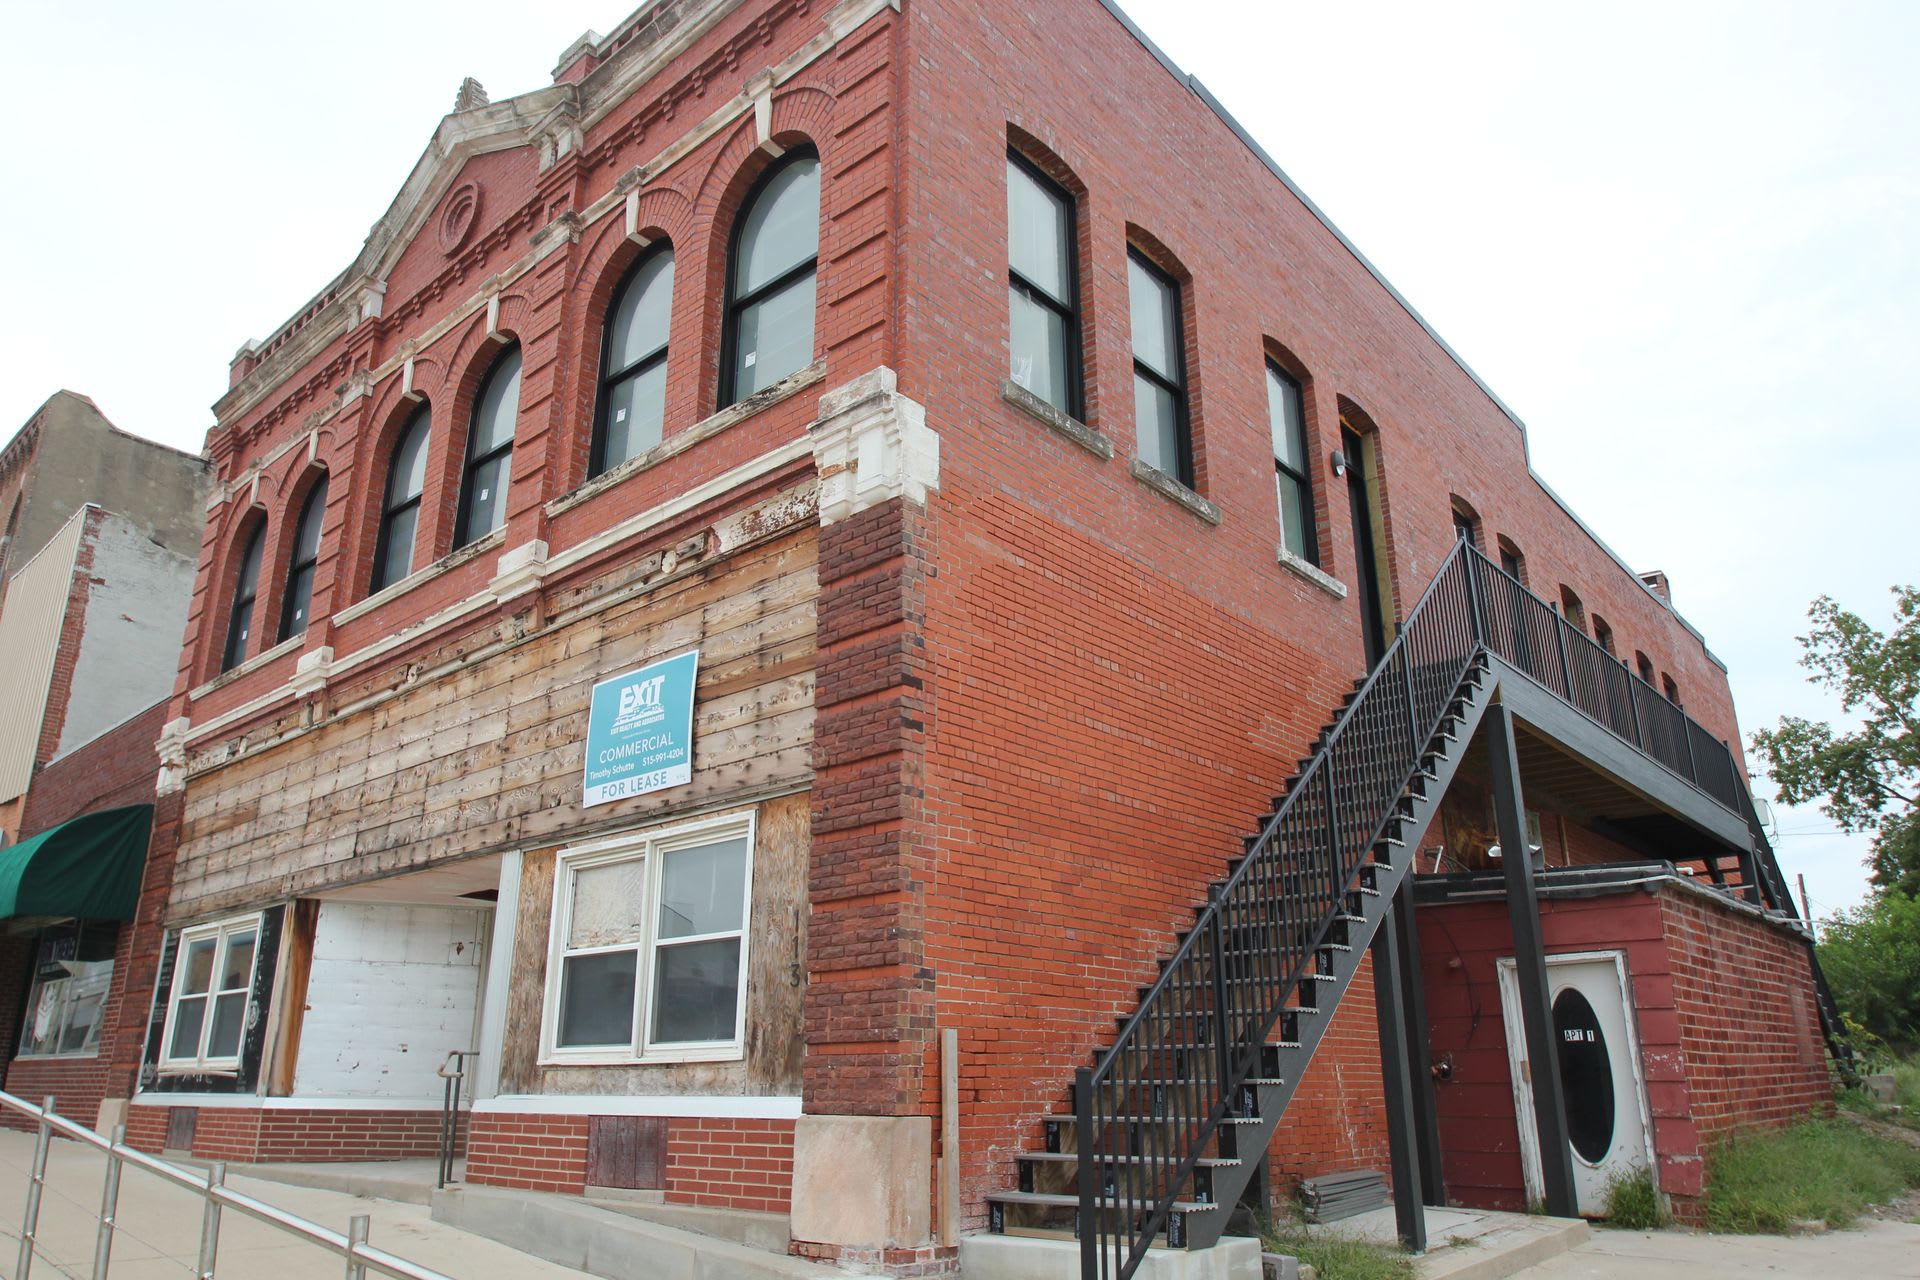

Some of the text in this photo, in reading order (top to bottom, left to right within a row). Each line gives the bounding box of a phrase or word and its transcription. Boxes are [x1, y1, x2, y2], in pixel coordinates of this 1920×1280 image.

[619, 722, 633, 733] REALTY
[633, 720, 642, 730] AND
[599, 732, 674, 764] COMMERCIAL
[590, 747, 684, 781] Timothy Schutte 515-991-4204
[601, 782, 625, 799] FOR
[630, 771, 668, 793] LEASE
[1565, 1029, 1582, 1041] APT
